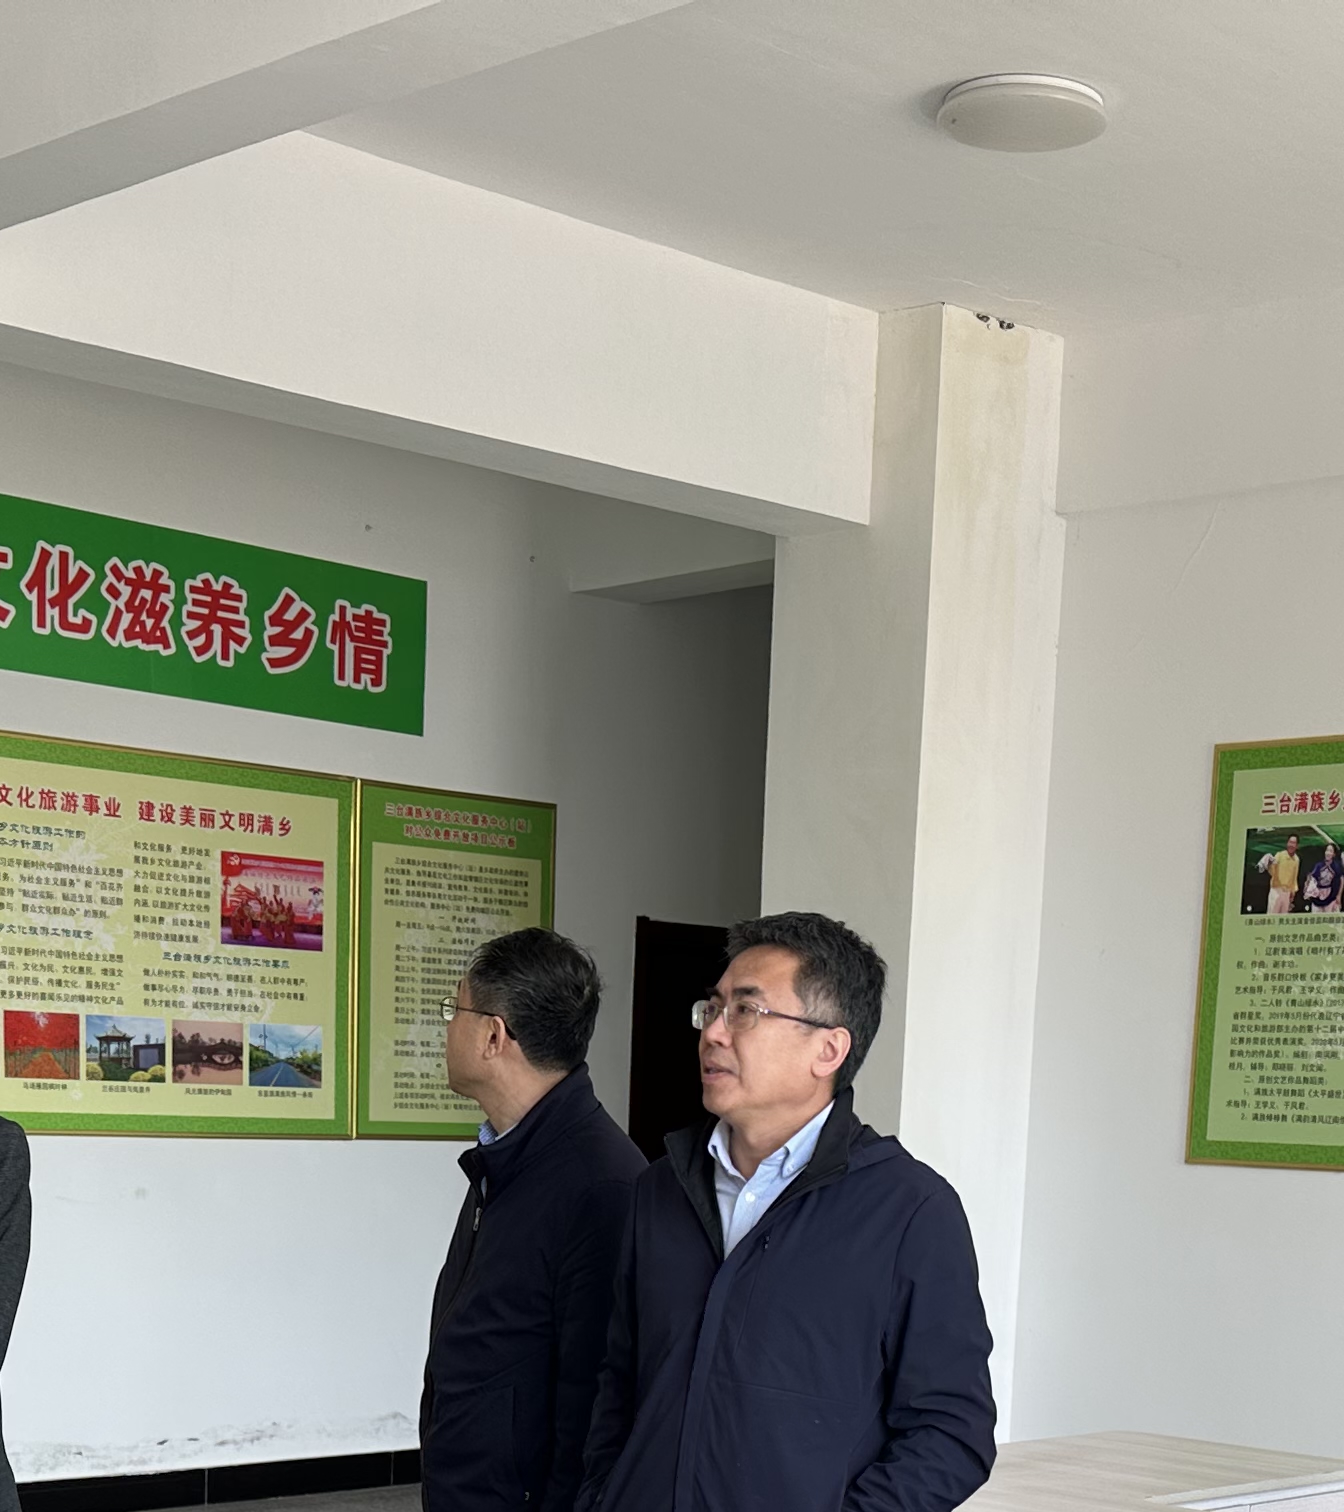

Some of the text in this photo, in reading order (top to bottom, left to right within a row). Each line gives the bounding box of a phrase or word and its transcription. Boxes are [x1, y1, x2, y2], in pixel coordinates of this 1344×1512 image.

[138, 798, 292, 838] 建设美丽文明满乡
